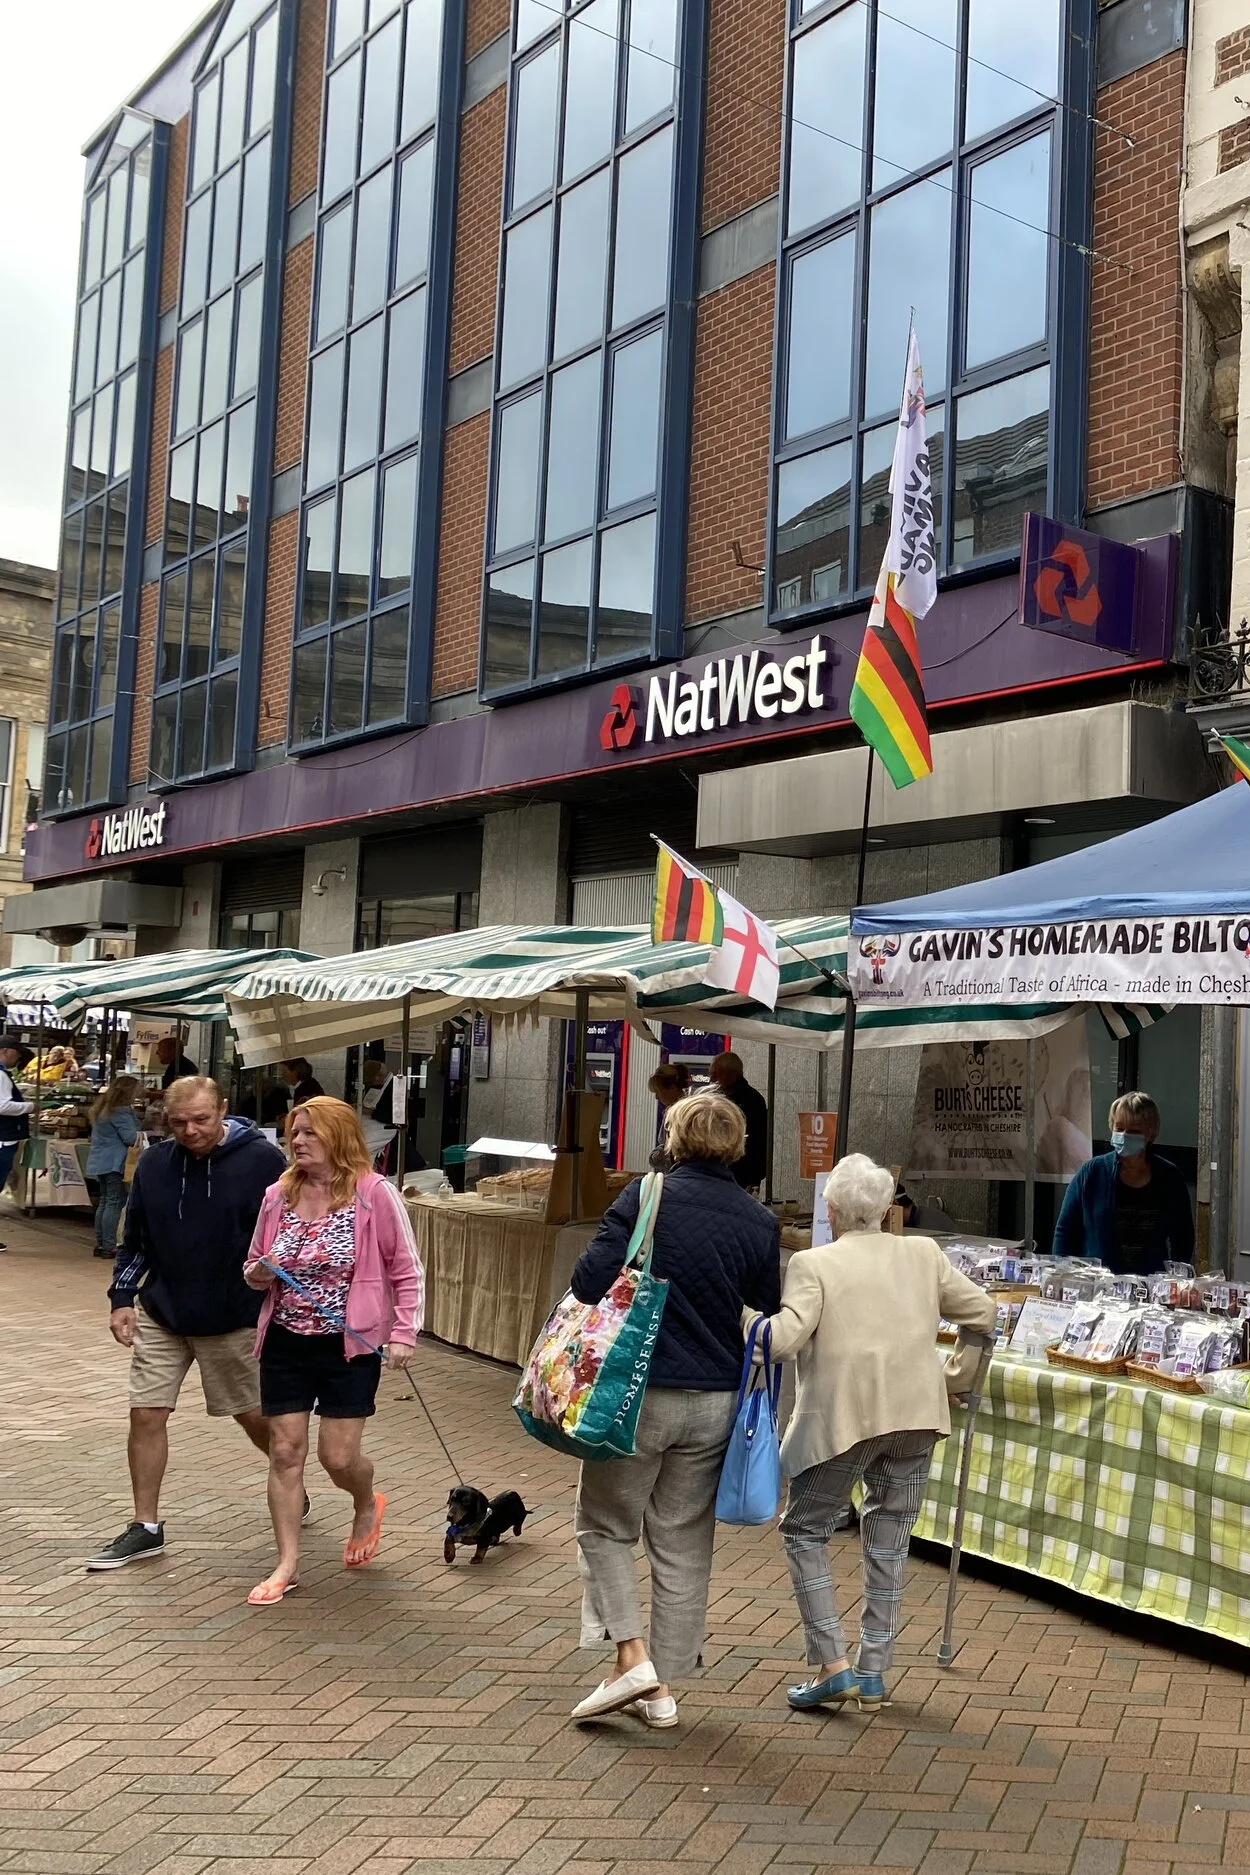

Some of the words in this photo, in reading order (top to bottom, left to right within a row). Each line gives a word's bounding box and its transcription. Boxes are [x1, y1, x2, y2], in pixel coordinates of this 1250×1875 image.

[644, 634, 827, 742] NatWest
[101, 802, 166, 856] NatWest
[909, 928, 1004, 963] GAVIN'S
[1009, 922, 1164, 956] HOMEMADE
[923, 981, 932, 997] A
[936, 977, 1003, 996] Traditional
[1008, 977, 1044, 994] Taste
[1049, 976, 1066, 992] of
[1067, 974, 1108, 992] Africa
[1125, 976, 1170, 993] made
[1176, 975, 1192, 993] in
[973, 1086, 1022, 1111] CHEESE
[935, 1123, 982, 1132] HANDCRAFTED
[990, 1123, 1021, 1132] CHESHIRE
